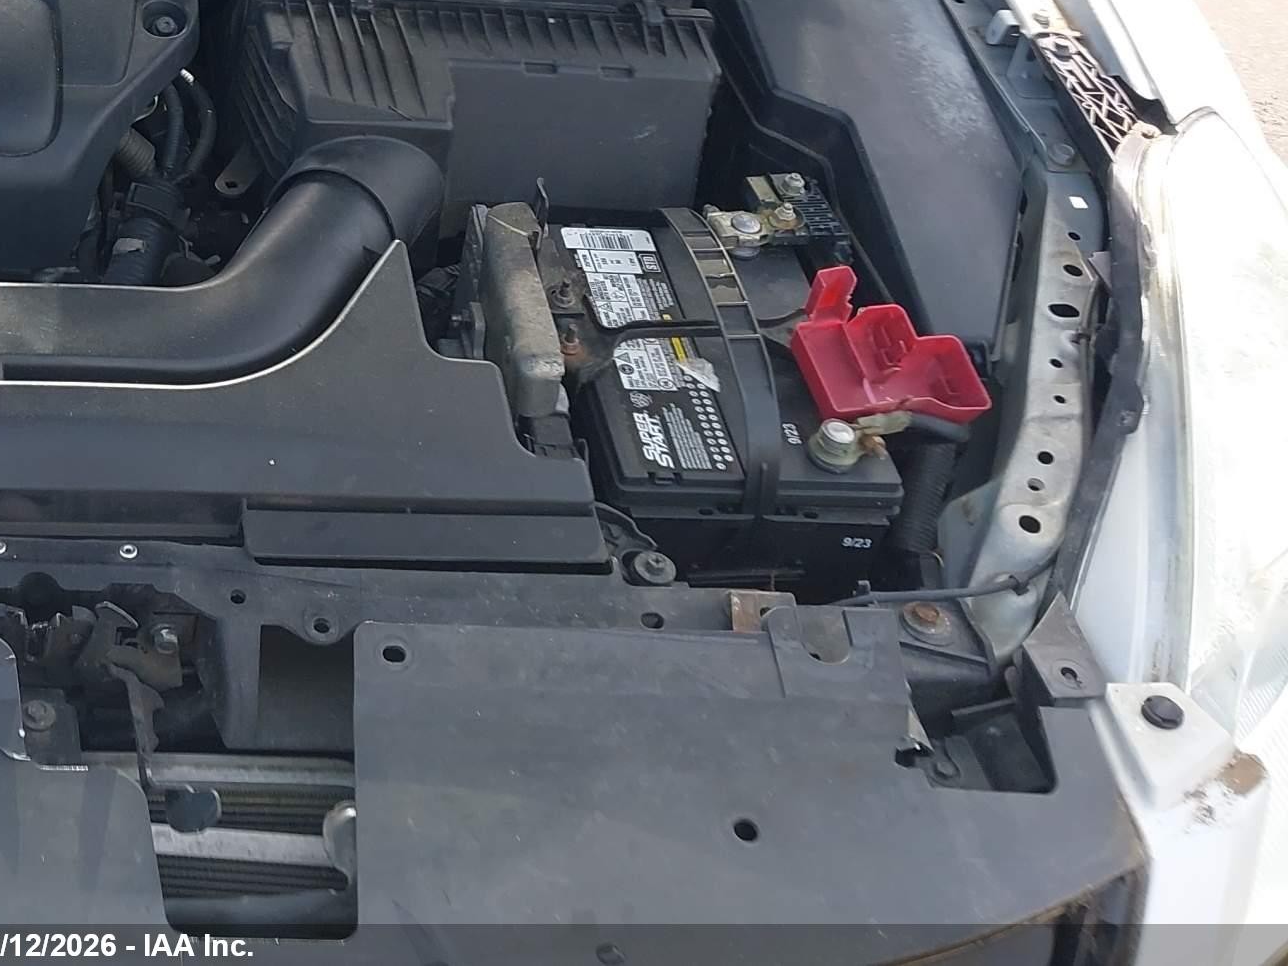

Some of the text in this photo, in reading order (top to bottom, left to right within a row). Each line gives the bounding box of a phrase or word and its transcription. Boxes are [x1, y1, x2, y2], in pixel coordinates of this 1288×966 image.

[632, 411, 656, 461] SUPER
[648, 416, 675, 469] START
[782, 423, 803, 445] 9/23
[841, 536, 873, 549] 9/23
